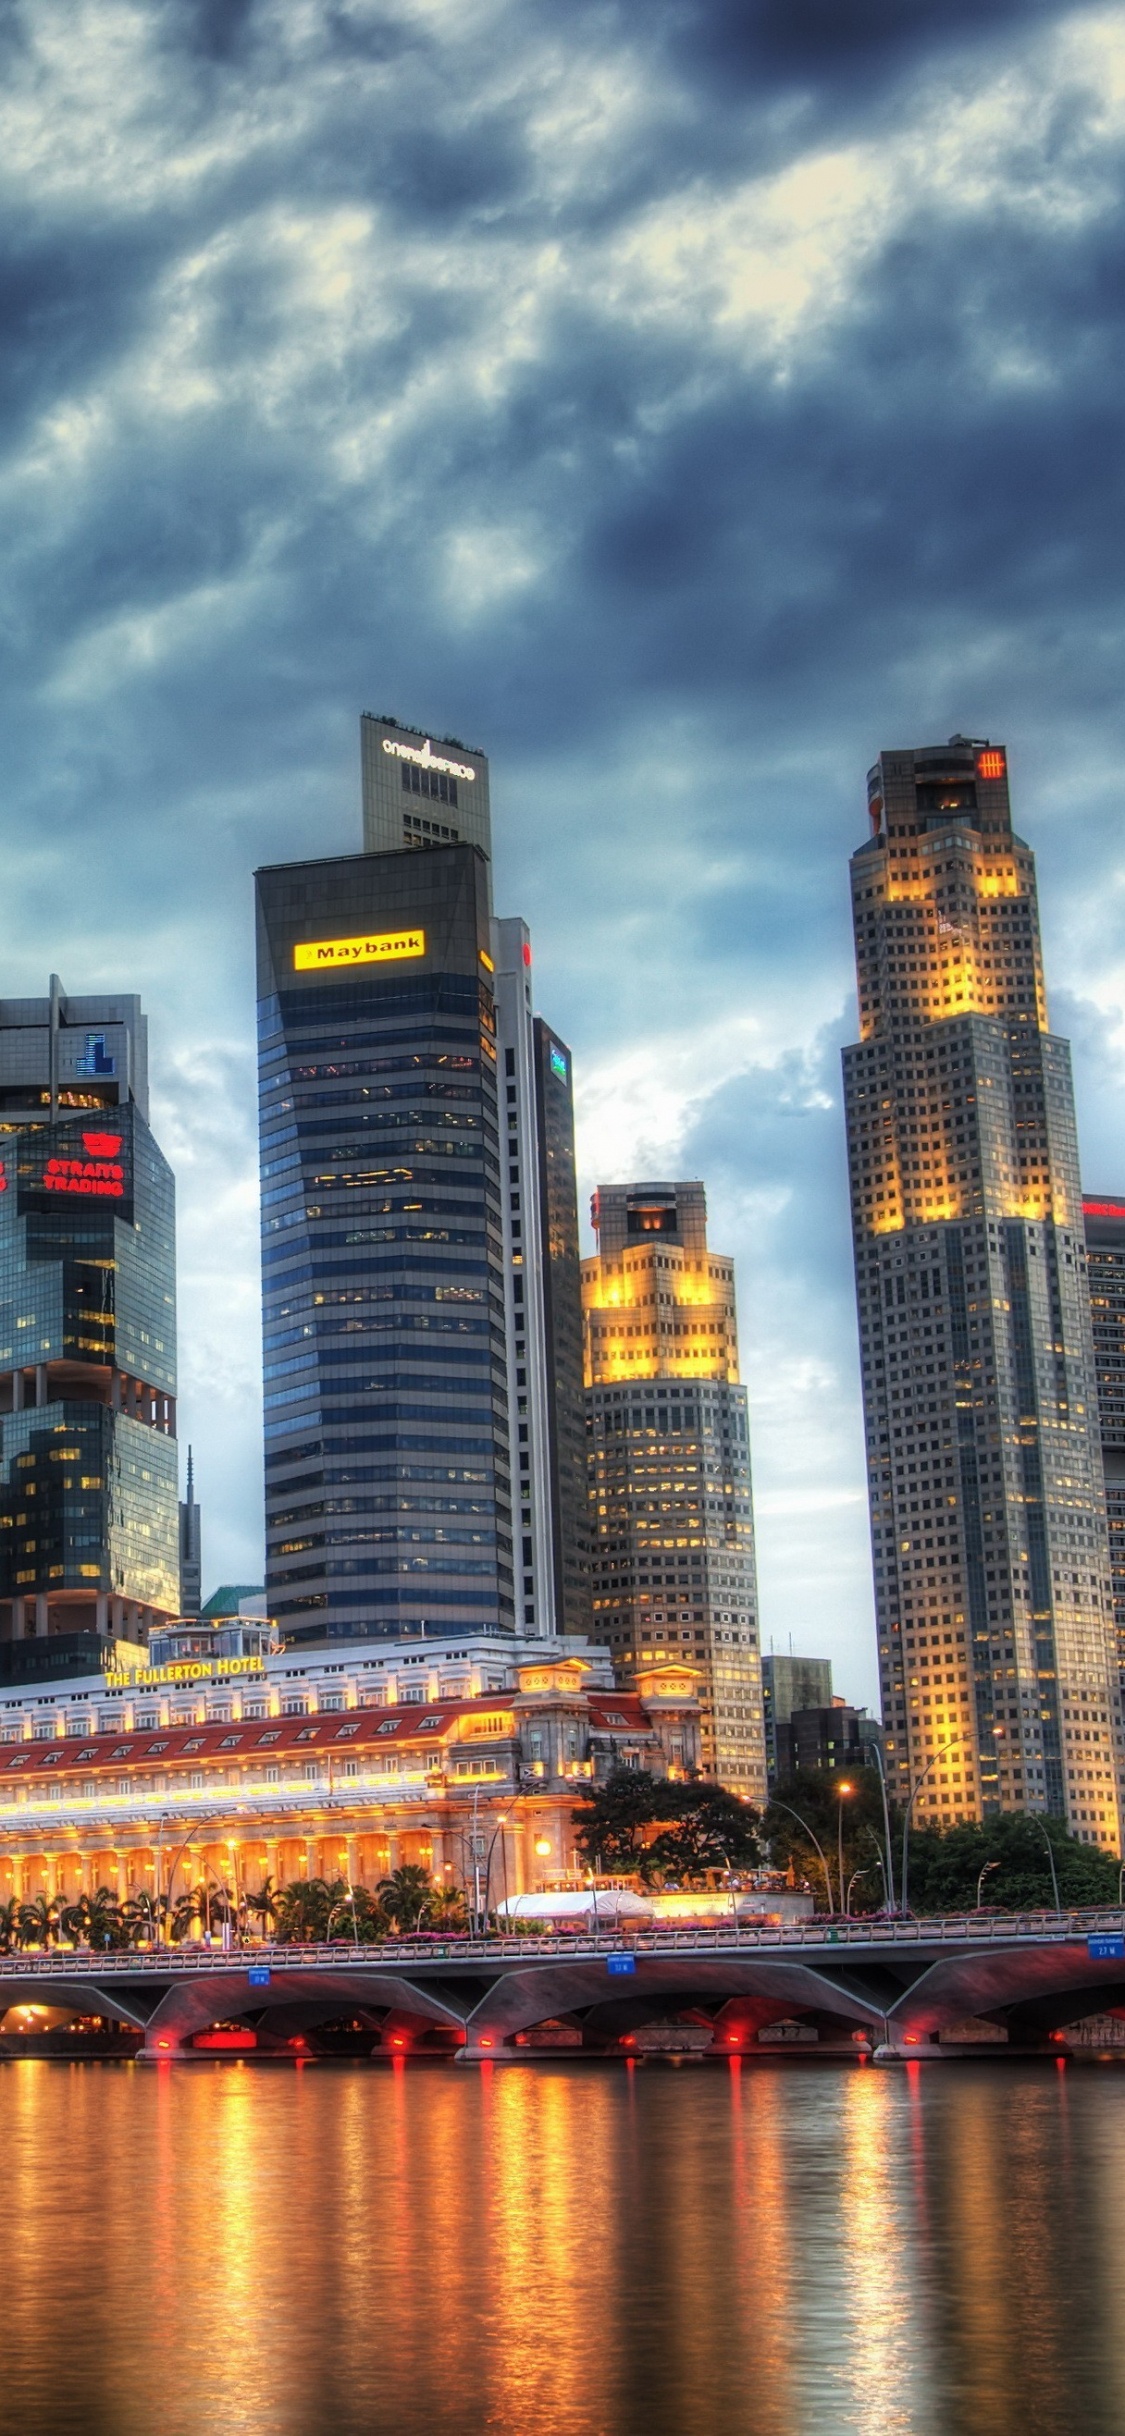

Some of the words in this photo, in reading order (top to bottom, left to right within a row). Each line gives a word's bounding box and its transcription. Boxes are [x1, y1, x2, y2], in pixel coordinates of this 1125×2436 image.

[317, 937, 420, 959] Maybank
[47, 1159, 124, 1180] STRAITS
[42, 1175, 124, 1197] TRADING
[105, 1671, 130, 1687] THE
[135, 1662, 212, 1685] FULLERTON
[217, 1656, 264, 1675] HOTEL
